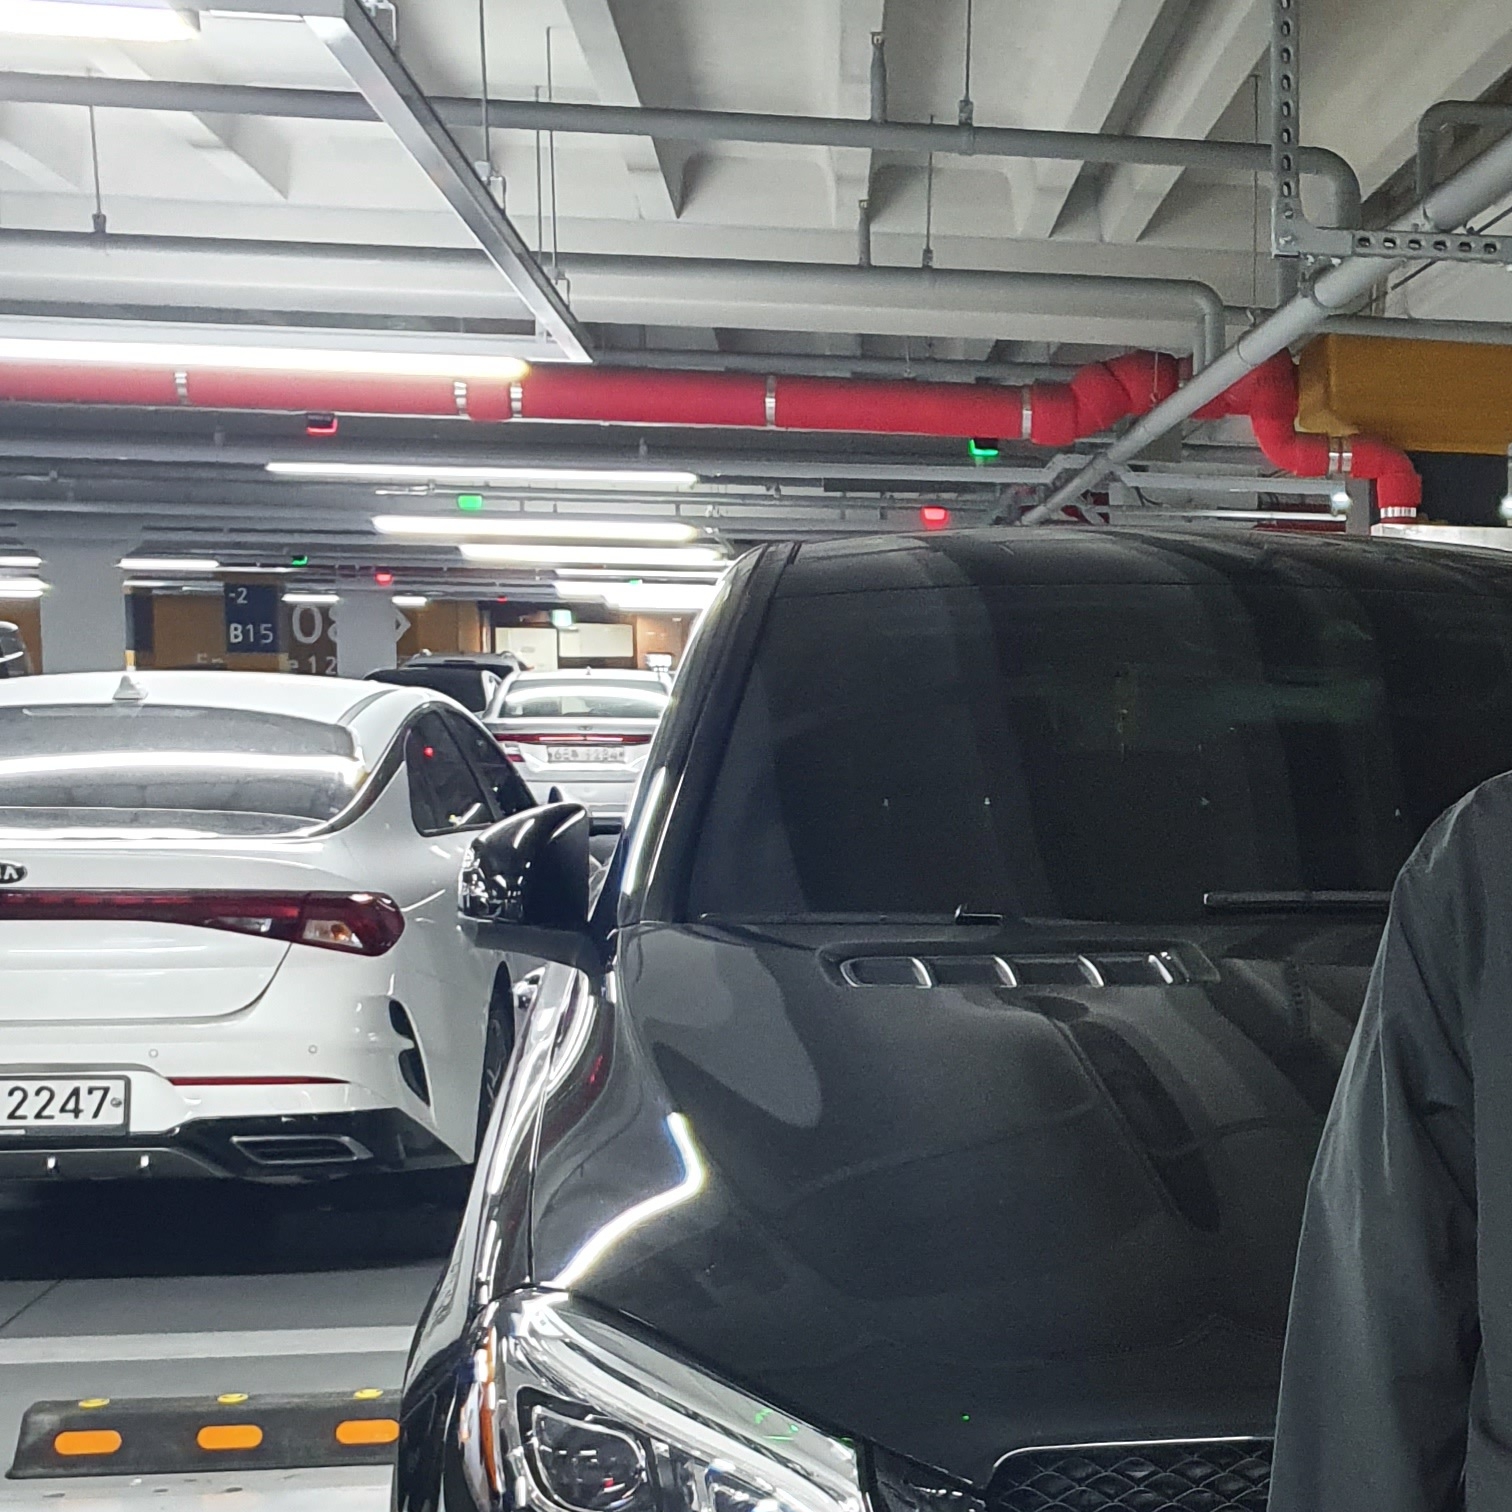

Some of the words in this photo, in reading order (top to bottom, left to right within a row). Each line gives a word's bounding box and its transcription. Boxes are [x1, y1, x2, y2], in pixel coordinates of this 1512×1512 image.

[228, 587, 248, 604] -2
[229, 623, 273, 644] B15
[7, 1085, 111, 1120] 2247
